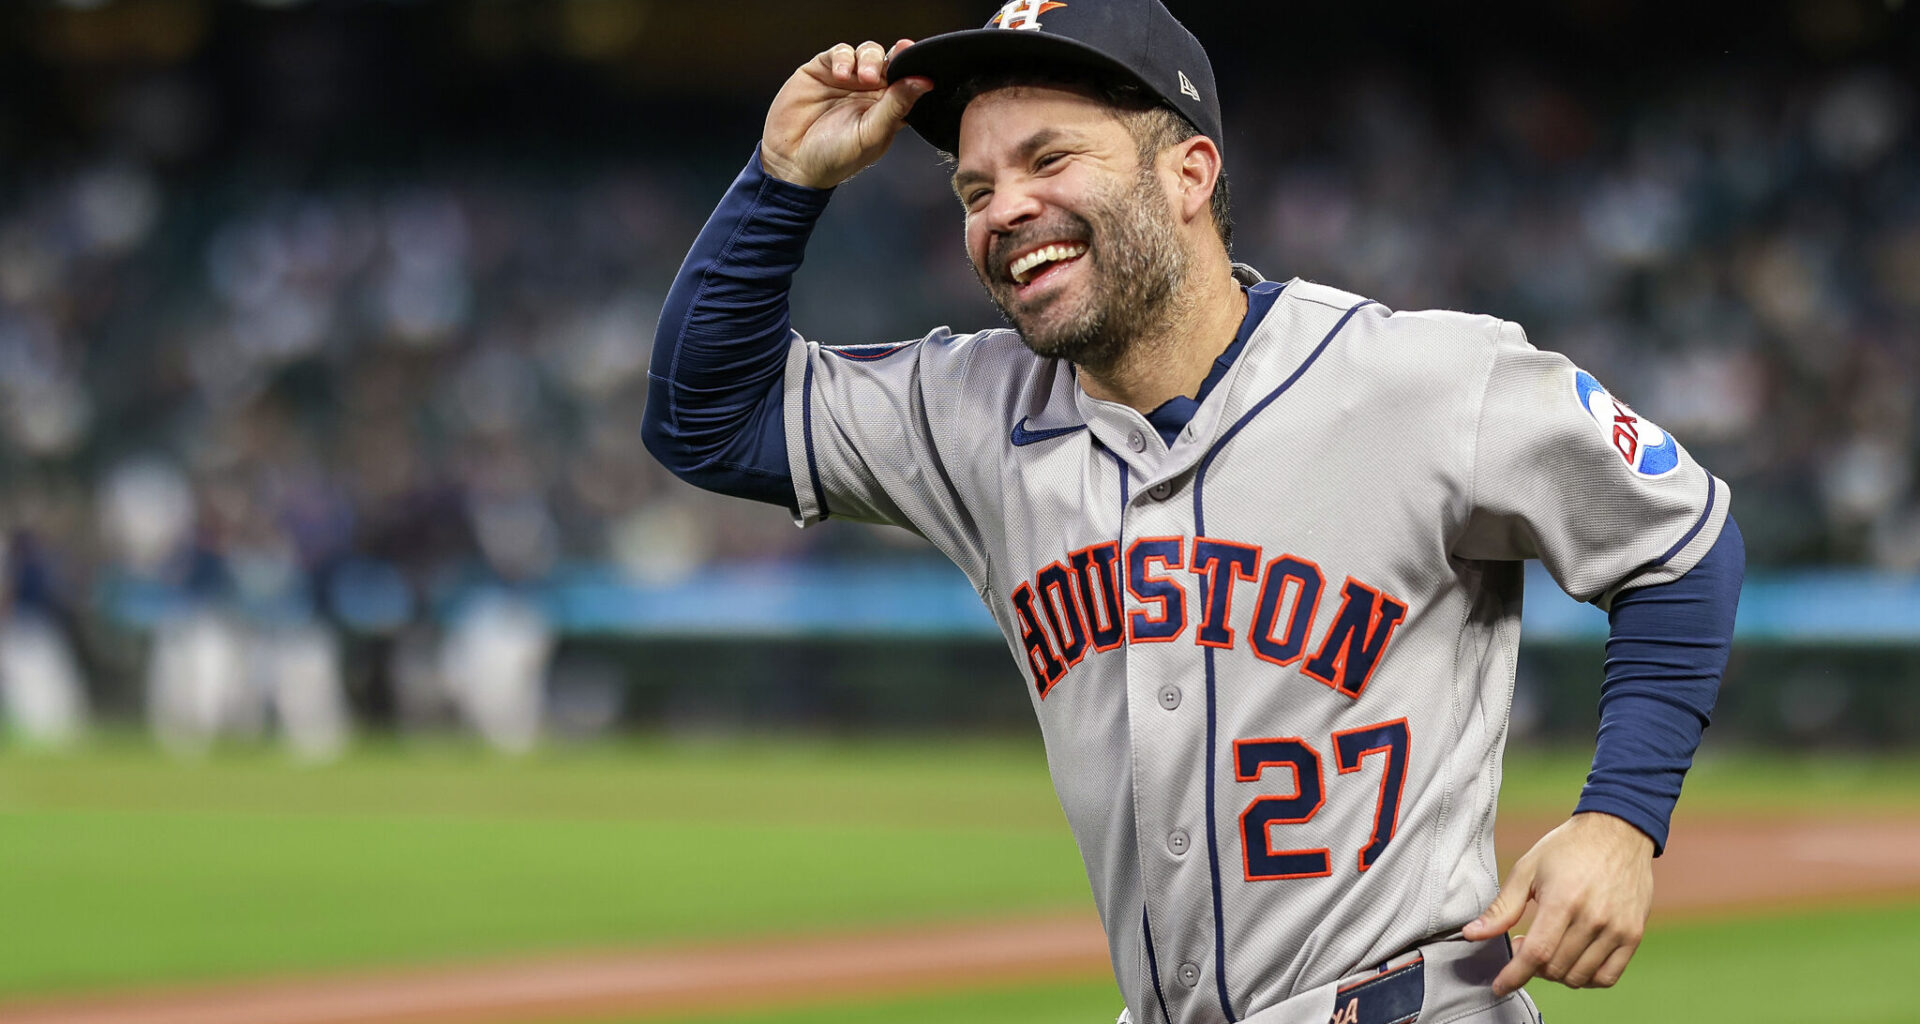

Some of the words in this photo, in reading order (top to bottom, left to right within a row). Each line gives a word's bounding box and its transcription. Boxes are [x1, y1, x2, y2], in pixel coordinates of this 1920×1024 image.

[1611, 397, 1639, 466] OX
[1011, 535, 1409, 700] HOUSTON
[1233, 717, 1411, 882] 27
